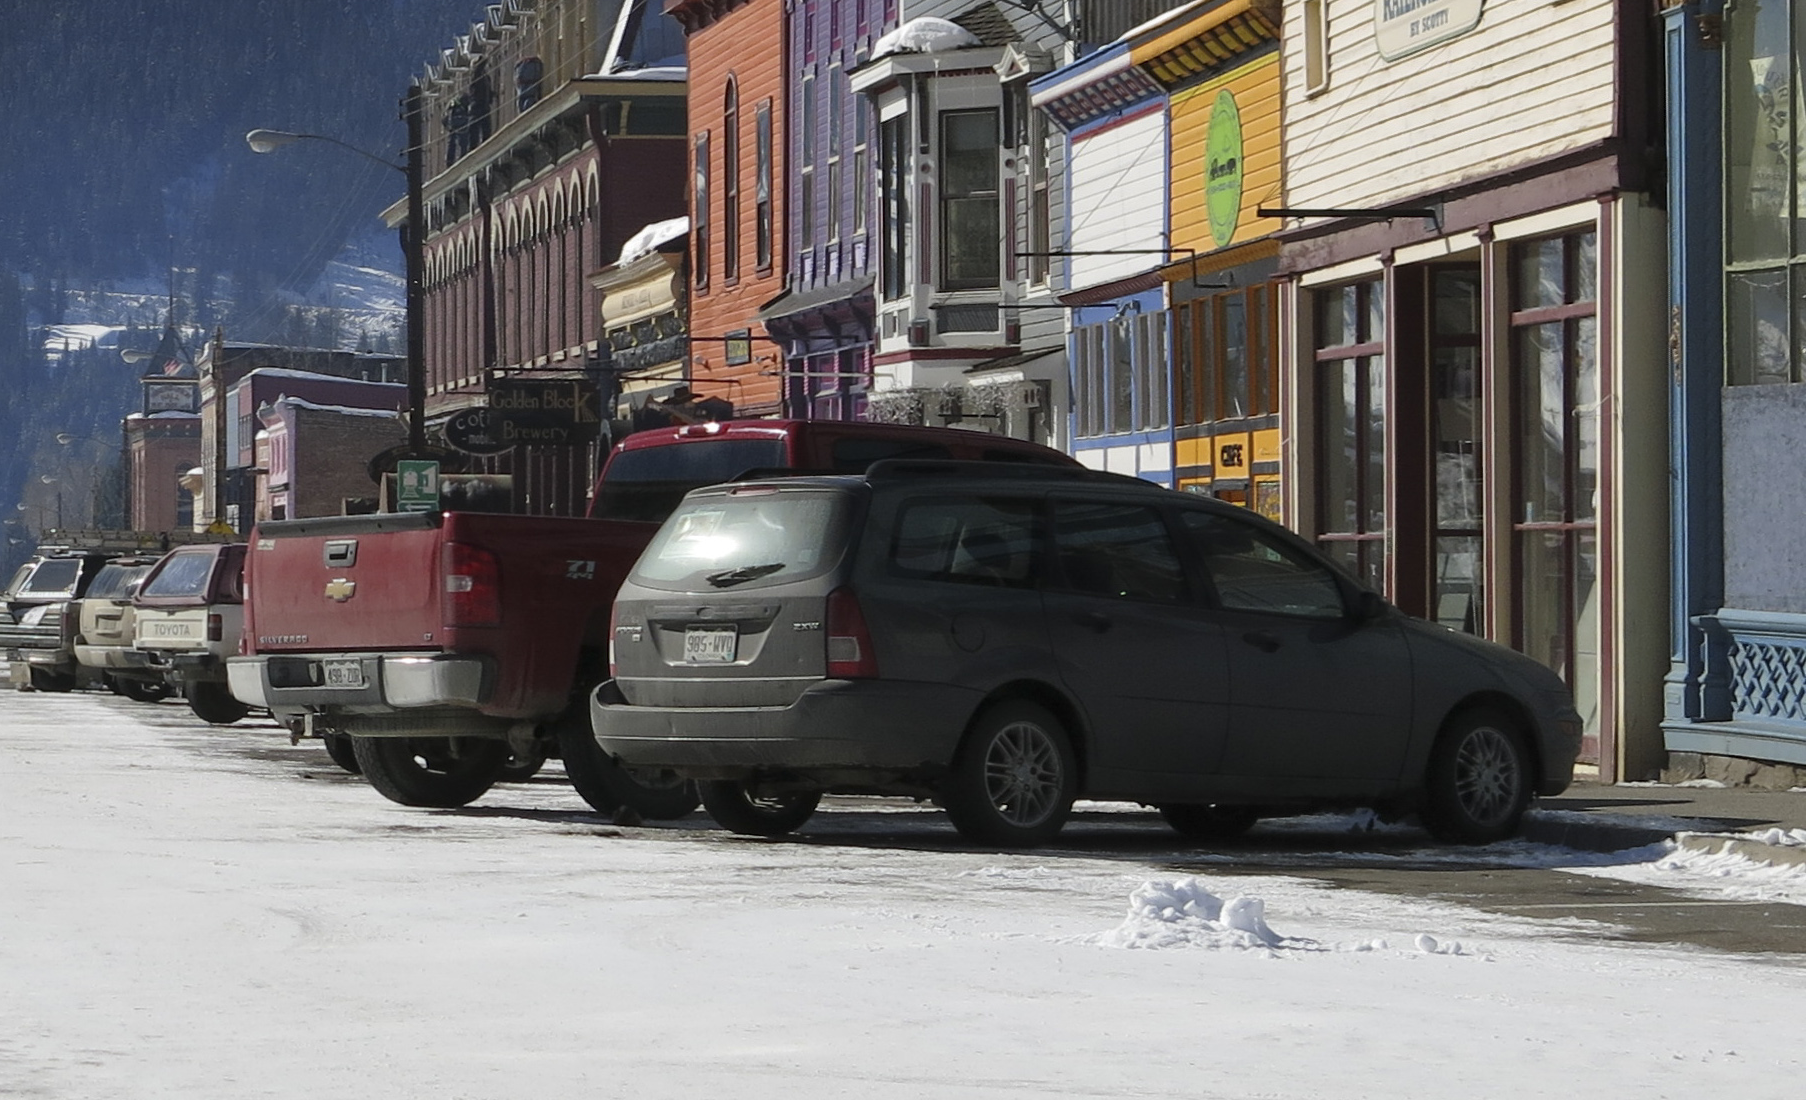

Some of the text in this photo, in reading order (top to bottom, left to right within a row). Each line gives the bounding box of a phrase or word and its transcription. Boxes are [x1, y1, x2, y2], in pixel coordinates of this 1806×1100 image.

[1410, 8, 1448, 37] BY SCOTTY
[492, 389, 539, 409] Golden
[504, 420, 569, 440] Brewery
[154, 624, 190, 635] TOYOTA
[259, 635, 308, 644] SILVERADO
